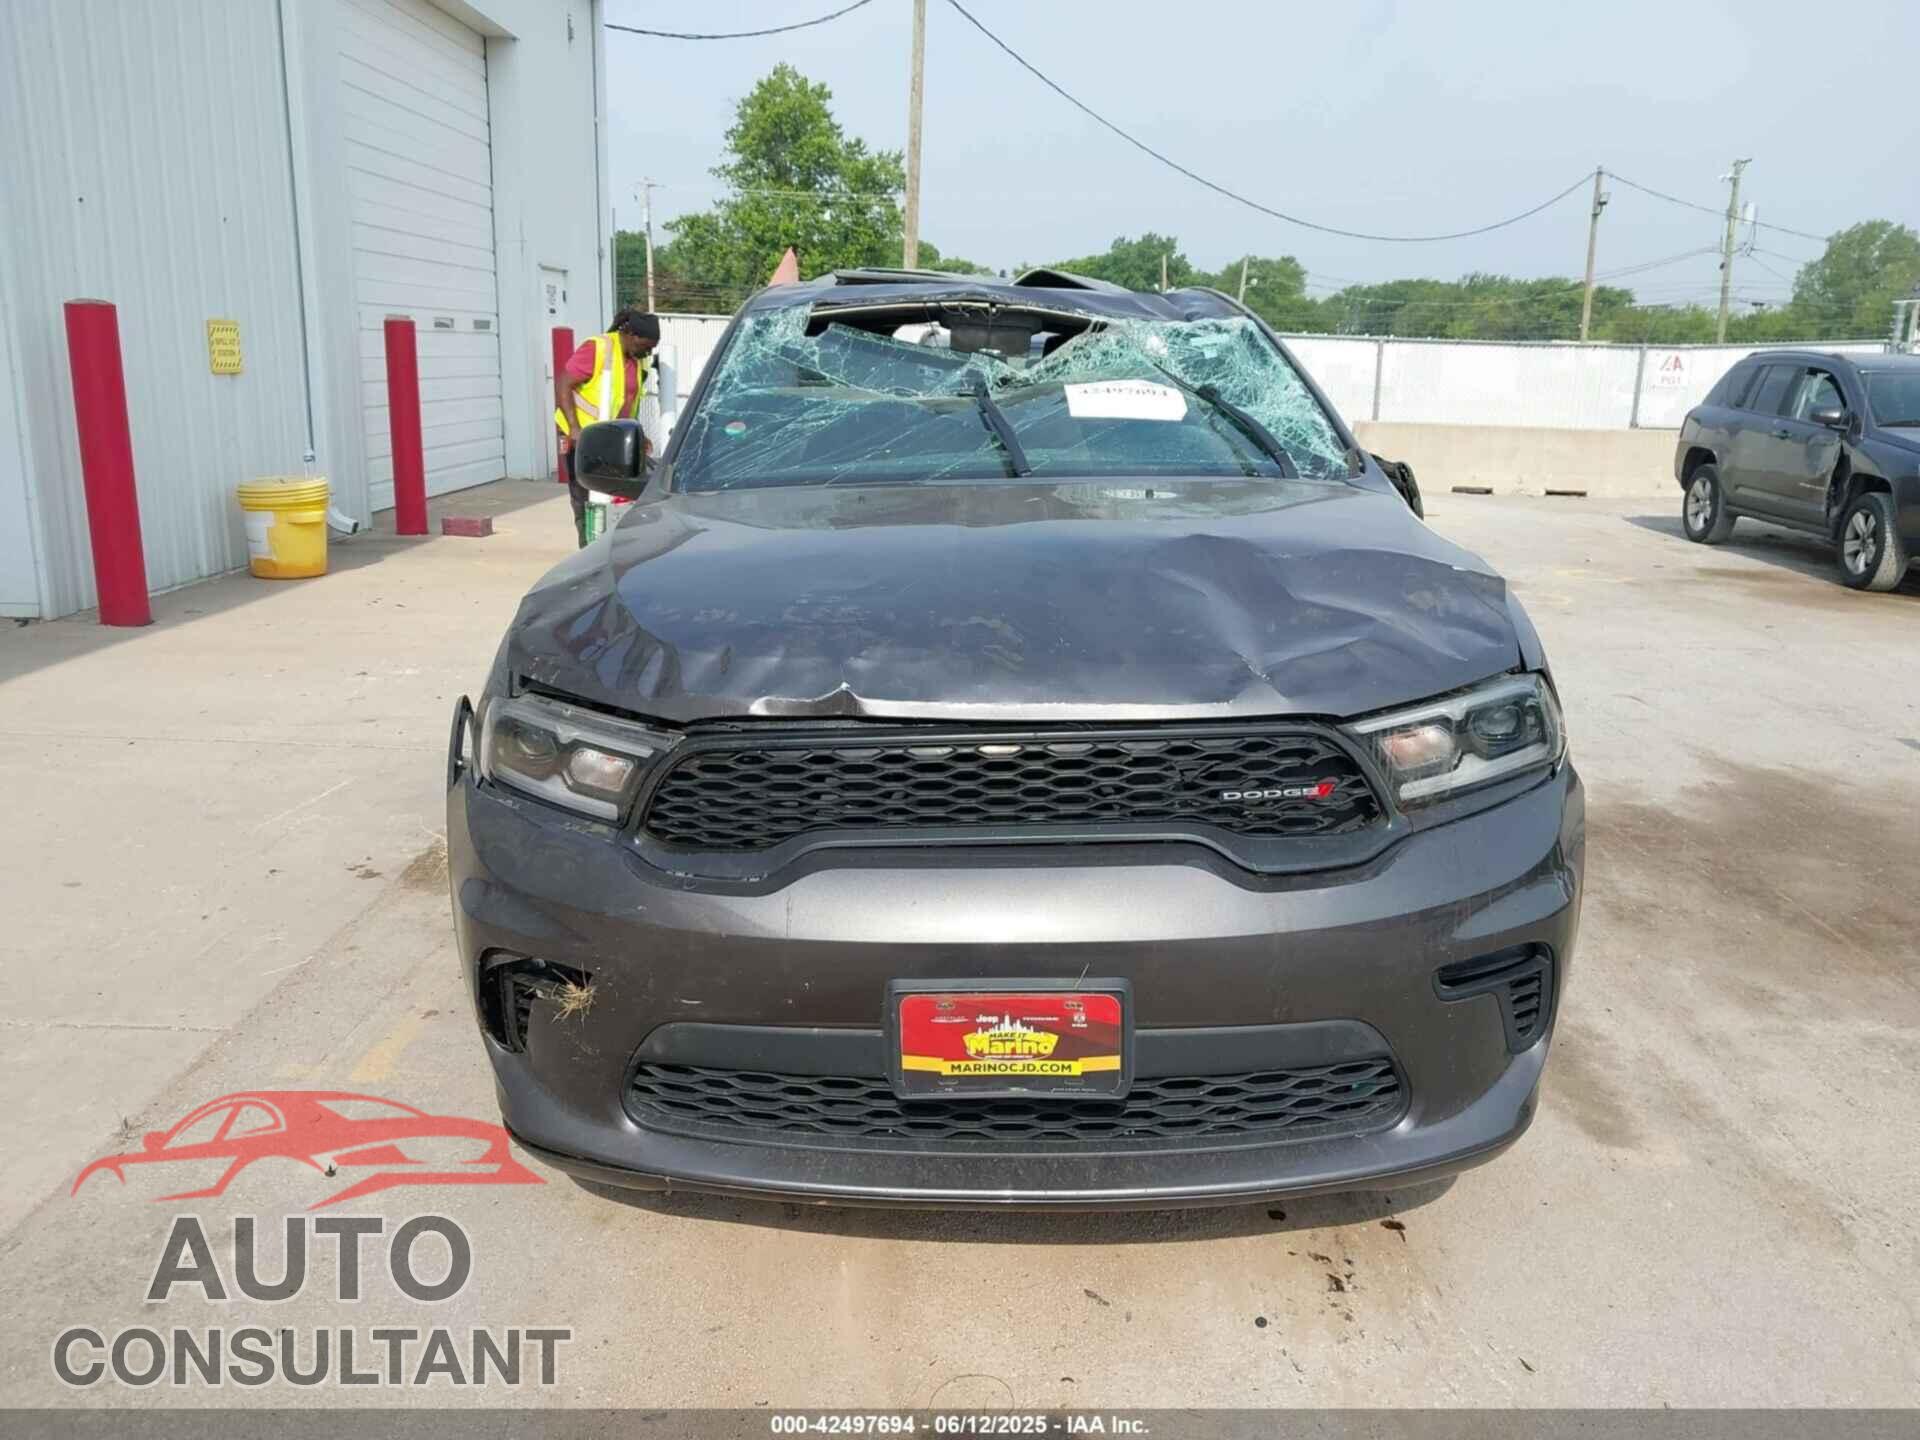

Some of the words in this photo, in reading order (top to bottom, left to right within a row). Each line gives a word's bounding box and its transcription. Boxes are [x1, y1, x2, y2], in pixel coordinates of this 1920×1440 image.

[1223, 787, 1319, 800] DODGE
[976, 1014, 998, 1024] Jeep
[969, 1037, 1054, 1055] Marino
[950, 1063, 1073, 1073] MARINOCJD.COM
